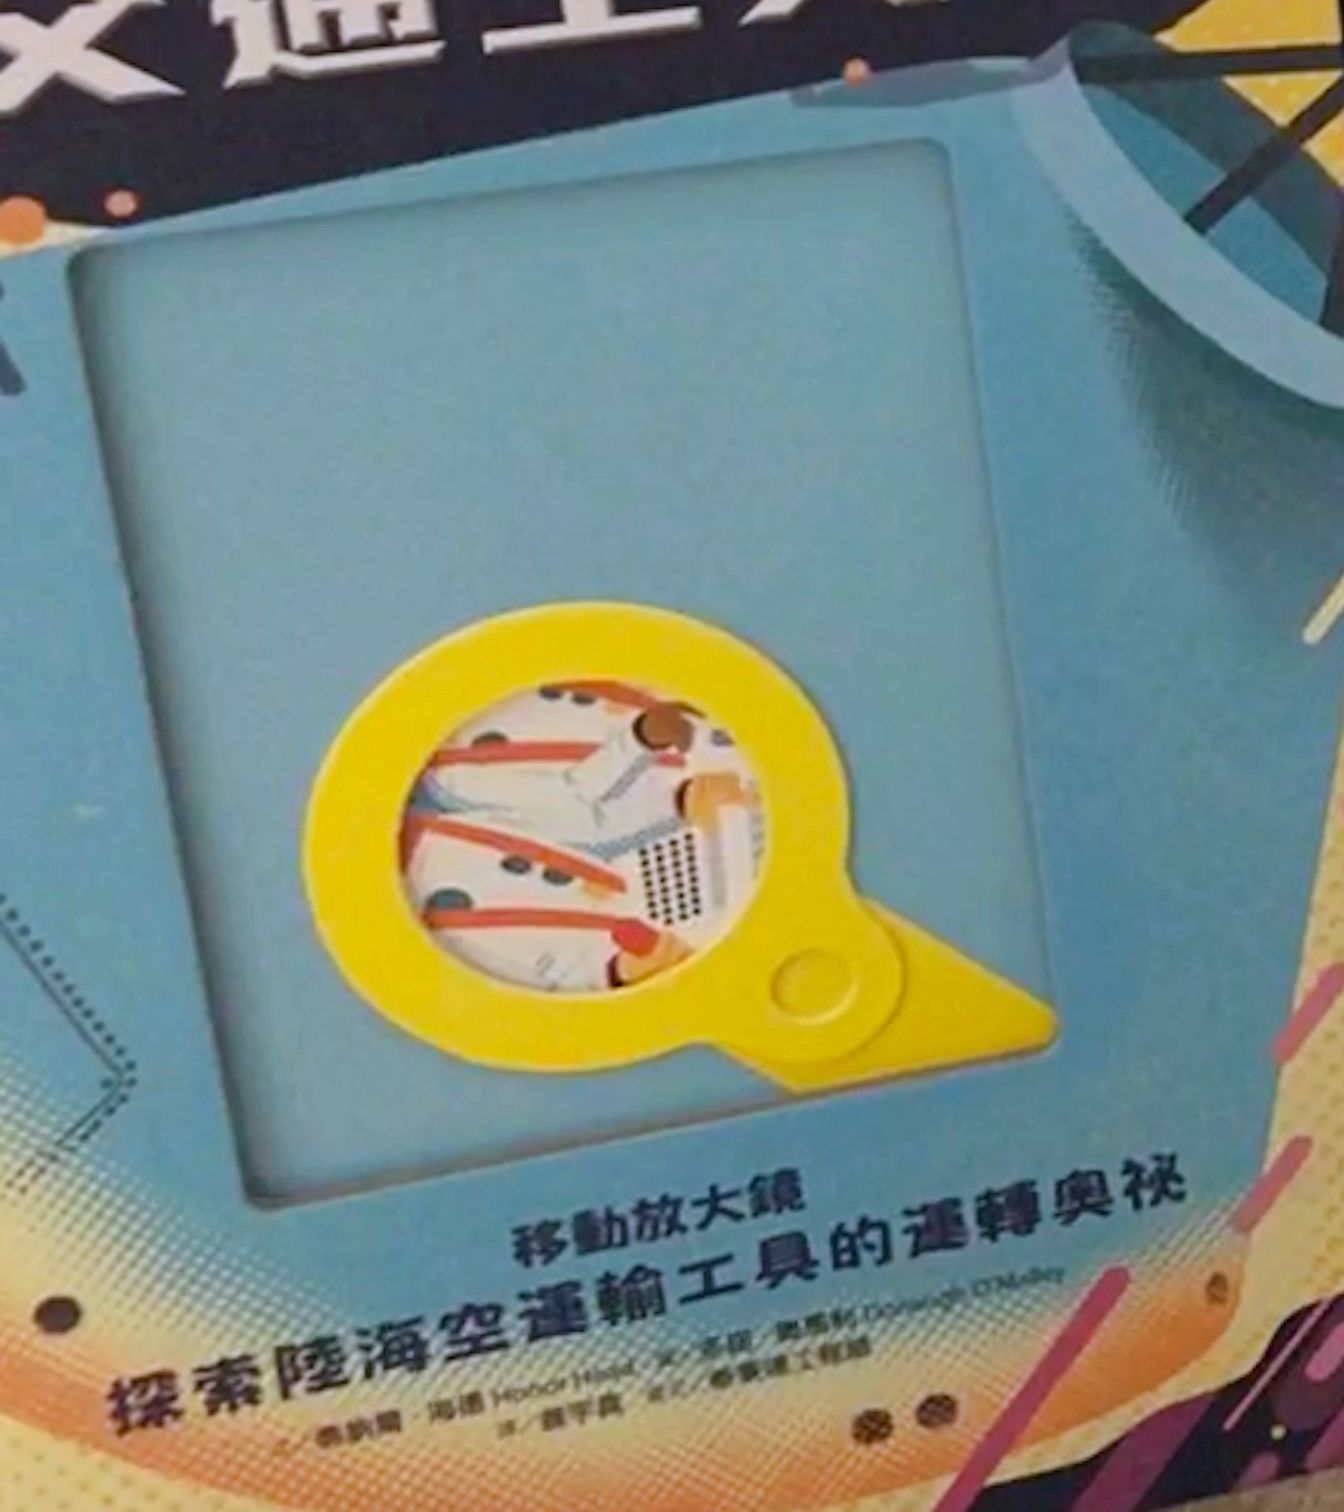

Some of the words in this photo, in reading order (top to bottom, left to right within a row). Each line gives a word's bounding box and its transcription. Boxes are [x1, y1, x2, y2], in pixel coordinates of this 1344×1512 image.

[509, 1166, 808, 1270] 移動放大鏡
